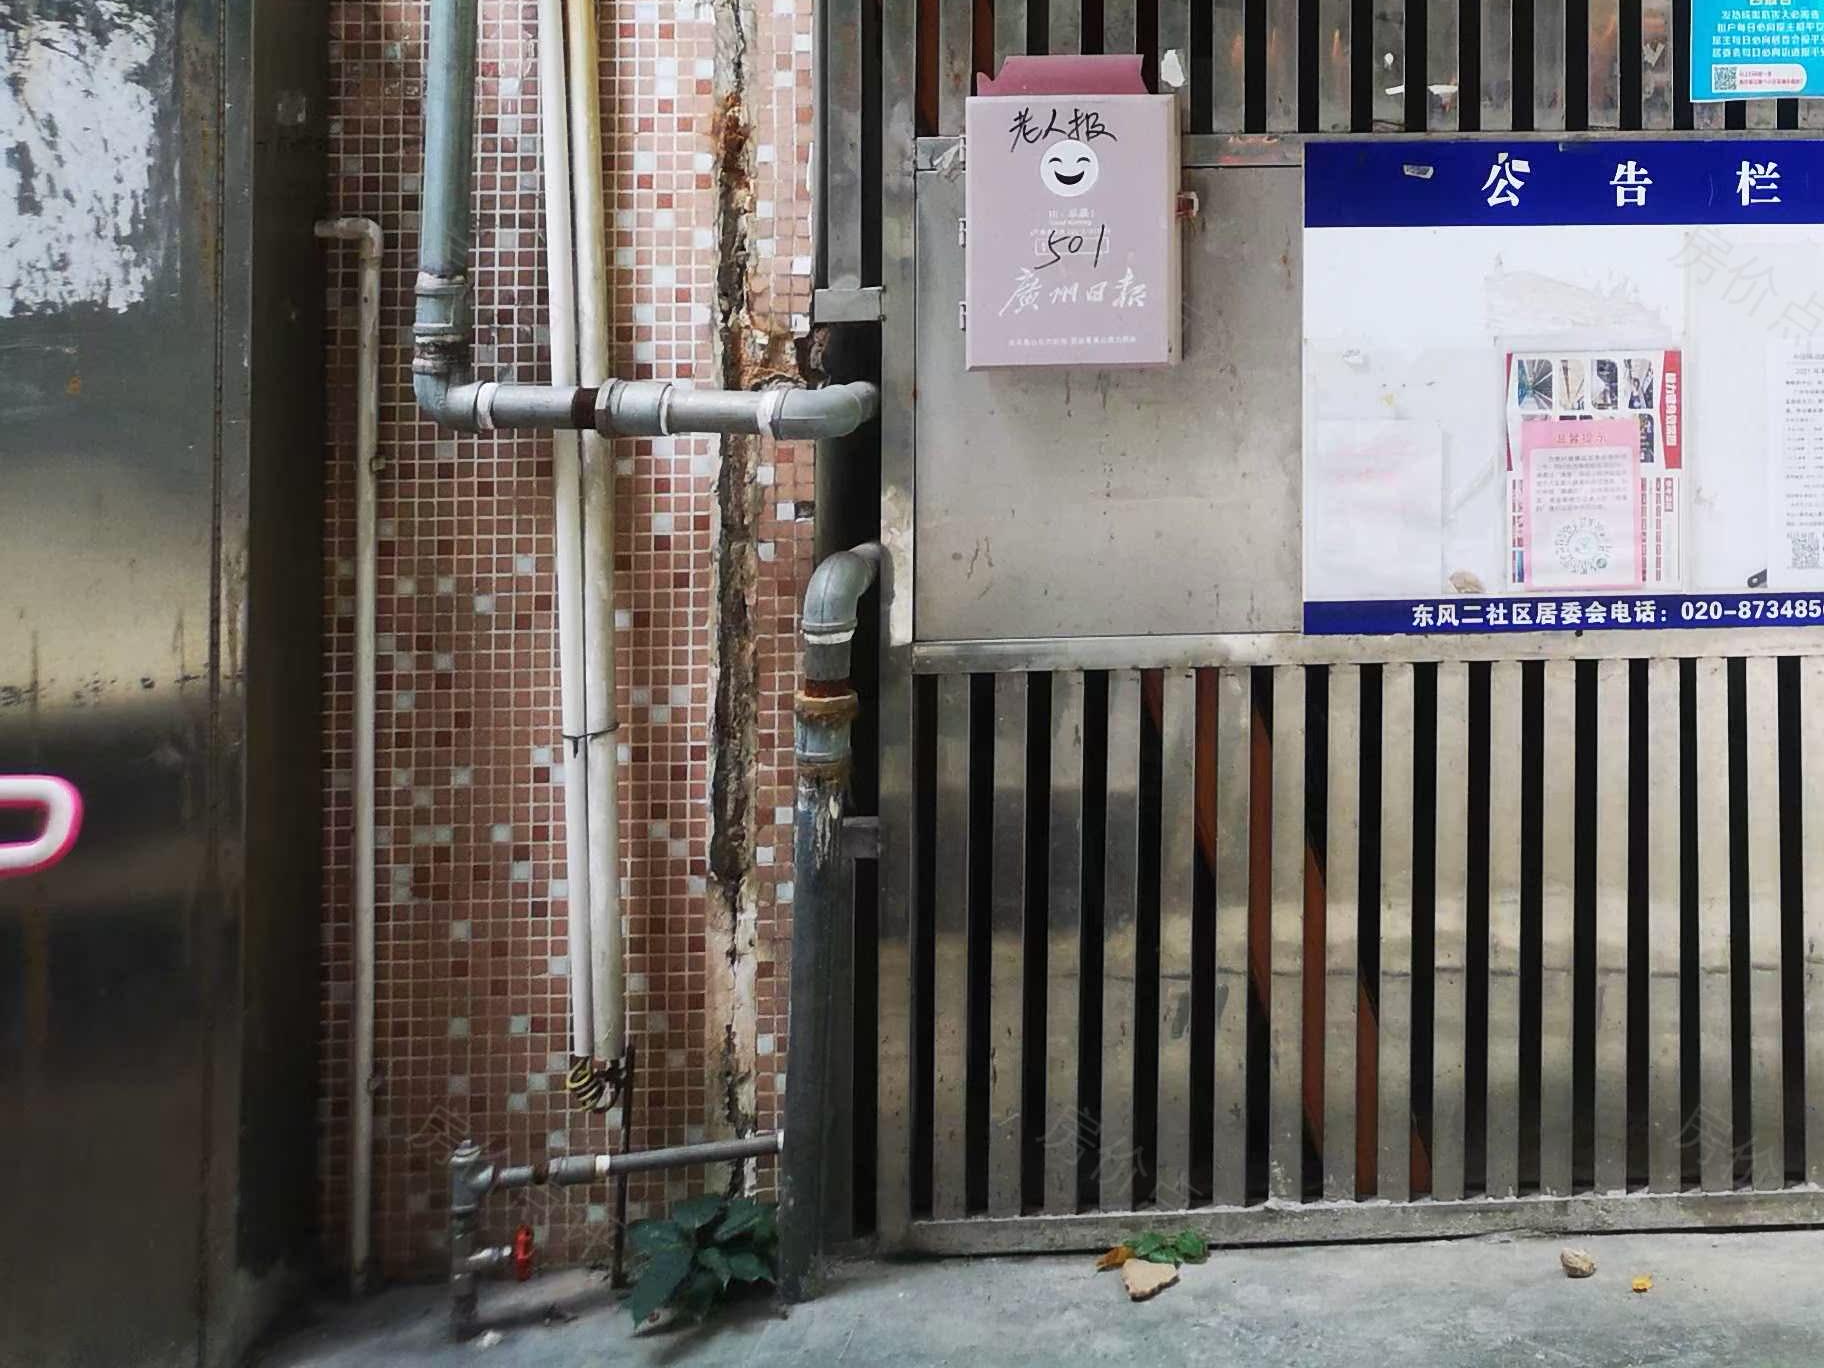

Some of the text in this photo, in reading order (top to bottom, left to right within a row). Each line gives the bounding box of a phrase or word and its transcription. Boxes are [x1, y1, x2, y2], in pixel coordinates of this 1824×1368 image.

[1009, 107, 1118, 152] 老人报
[1481, 155, 1782, 207] 公告栏
[1034, 224, 1105, 270] 501
